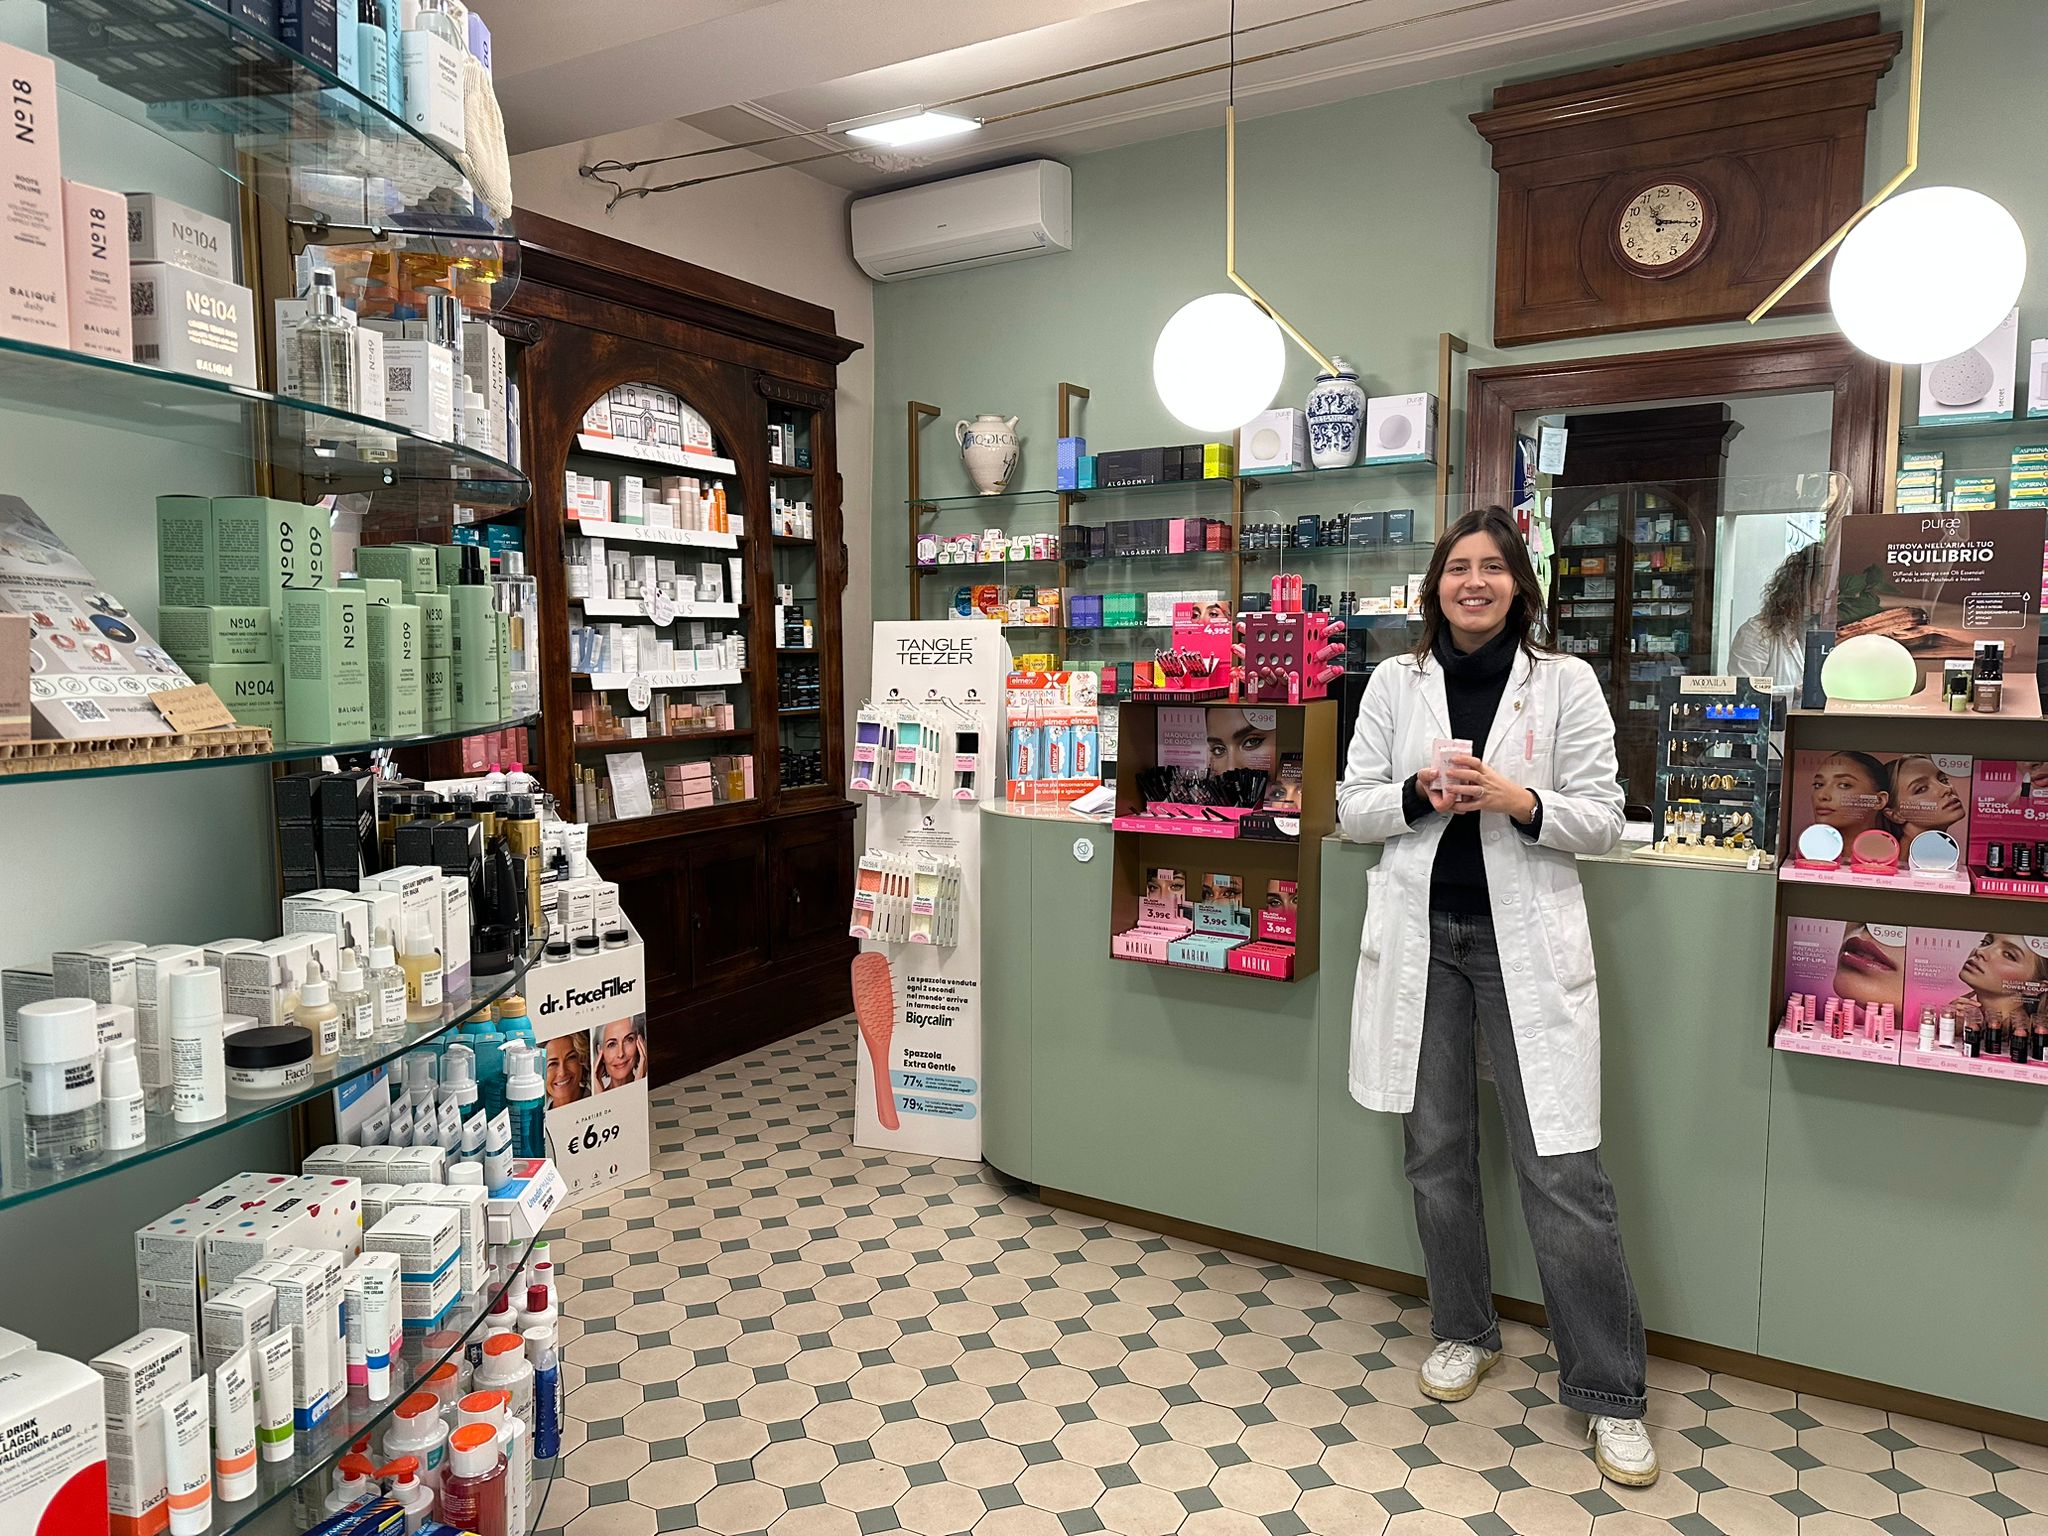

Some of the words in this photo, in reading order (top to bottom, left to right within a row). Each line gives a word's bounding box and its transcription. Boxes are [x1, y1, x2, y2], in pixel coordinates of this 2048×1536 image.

[1626, 237, 1635, 248] 8
[1680, 232, 1691, 244] 4
[1669, 246, 1678, 256] 5
[1959, 496, 1985, 504] ASPIRINA
[2015, 500, 2045, 508] ASPIRINA
[1924, 541, 1966, 549] NELL'ARIA
[1887, 548, 1994, 566] EQUILIBRIO
[1203, 624, 1231, 636] 4,99€
[896, 638, 973, 652] TANGLE
[896, 652, 973, 665] TEEZER
[1044, 718, 1069, 726] elmex
[1070, 718, 1095, 726] elmex
[1249, 712, 1274, 723] 2,99€
[1020, 746, 1028, 775] elmex
[1077, 746, 1086, 771] elmex
[1938, 758, 1970, 769] 6,99€
[1978, 807, 2022, 815] VOLUME
[1147, 908, 1171, 920] 3,99€
[1202, 914, 1228, 927] 3,99€
[1266, 921, 1292, 935] 3,99€
[1873, 927, 1903, 938] 5,99€
[907, 975, 916, 983] La
[916, 978, 947, 986] spazzola
[947, 978, 977, 987] venduta
[907, 984, 923, 993] ogni
[928, 985, 956, 994] secondi
[539, 994, 566, 1017] dr.
[565, 976, 637, 1008] FaceFiller
[946, 996, 968, 1004] arriva
[913, 1001, 944, 1011] farmacia
[944, 1004, 960, 1012] con
[904, 1049, 942, 1060] Spazzola
[904, 1059, 927, 1069] Extra
[928, 1063, 957, 1072] Gentle
[903, 1074, 923, 1088] 77%
[903, 1097, 924, 1111] 79%
[582, 1124, 620, 1149] 6,99
[134, 1360, 160, 1378] INSTANT
[160, 1346, 183, 1366] BRIGHT
[143, 1365, 166, 1384] CREAM
[6, 1417, 38, 1439] DRINK
[50, 1424, 73, 1443] ACID
